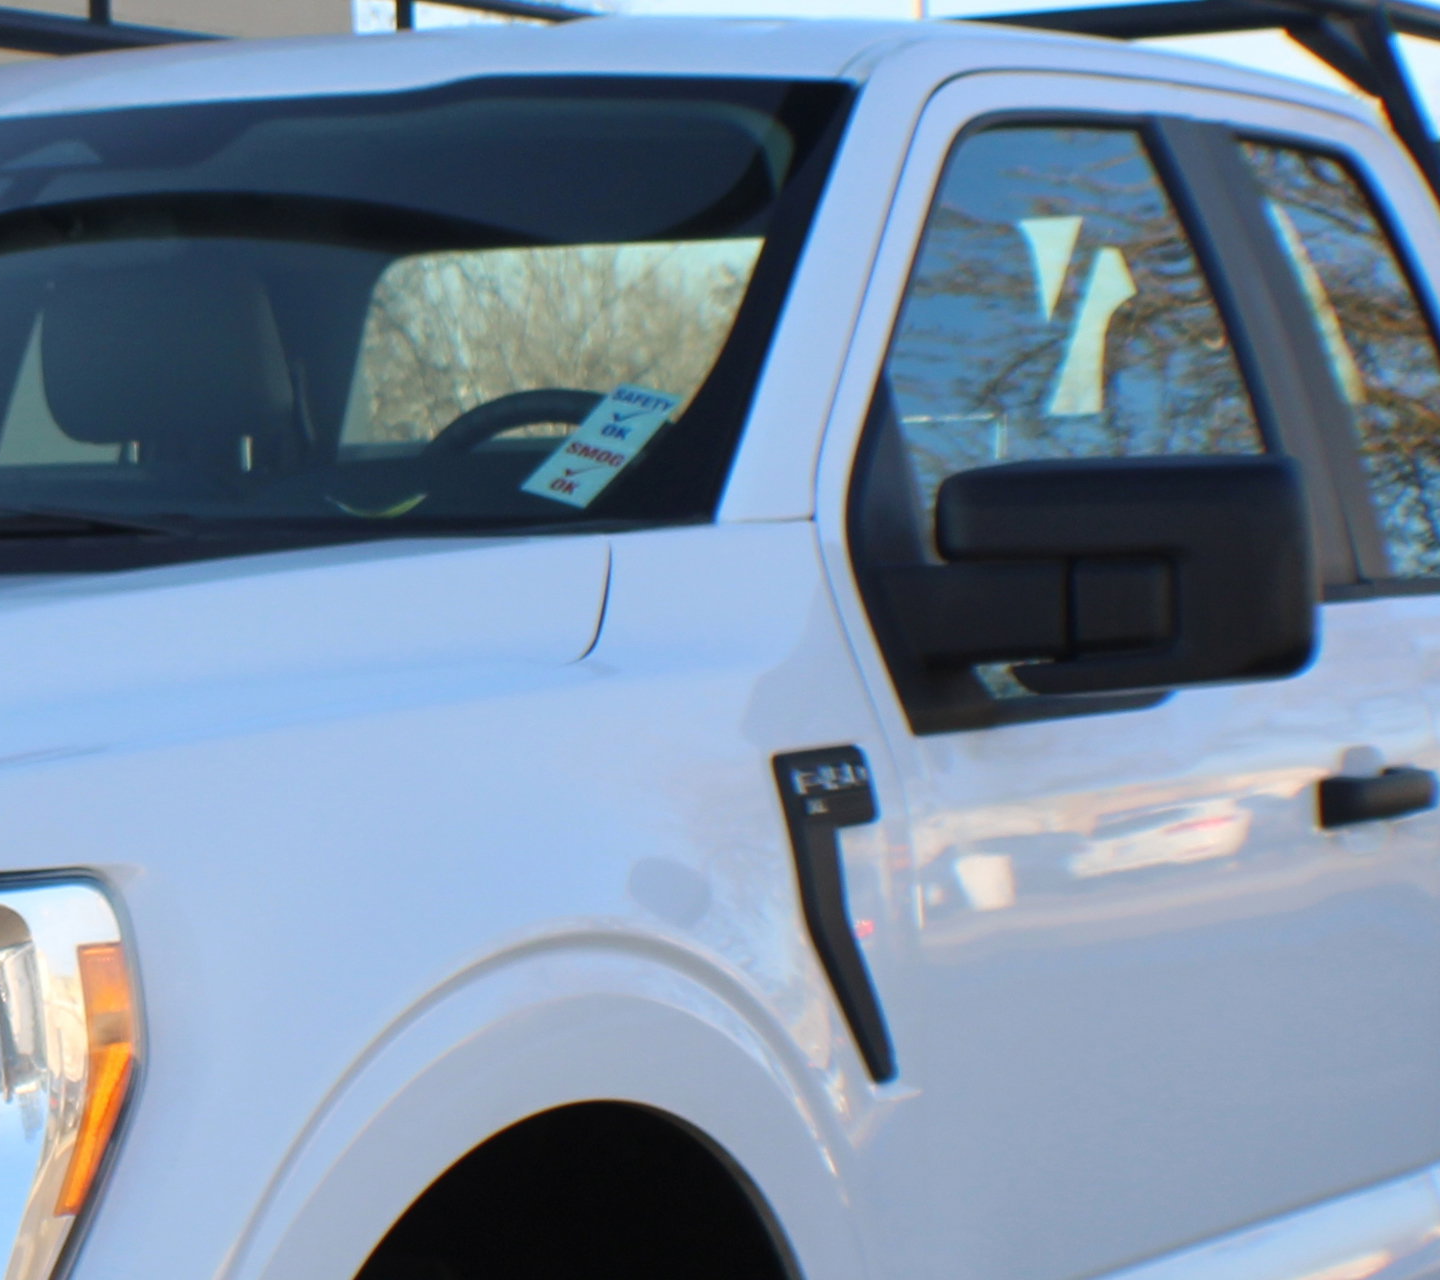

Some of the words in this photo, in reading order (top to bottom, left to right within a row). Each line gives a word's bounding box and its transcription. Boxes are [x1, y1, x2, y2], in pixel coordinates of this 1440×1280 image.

[613, 389, 674, 410] SAFETY
[601, 424, 632, 440] OK
[567, 442, 625, 466] SMOG
[551, 478, 578, 494] OK
